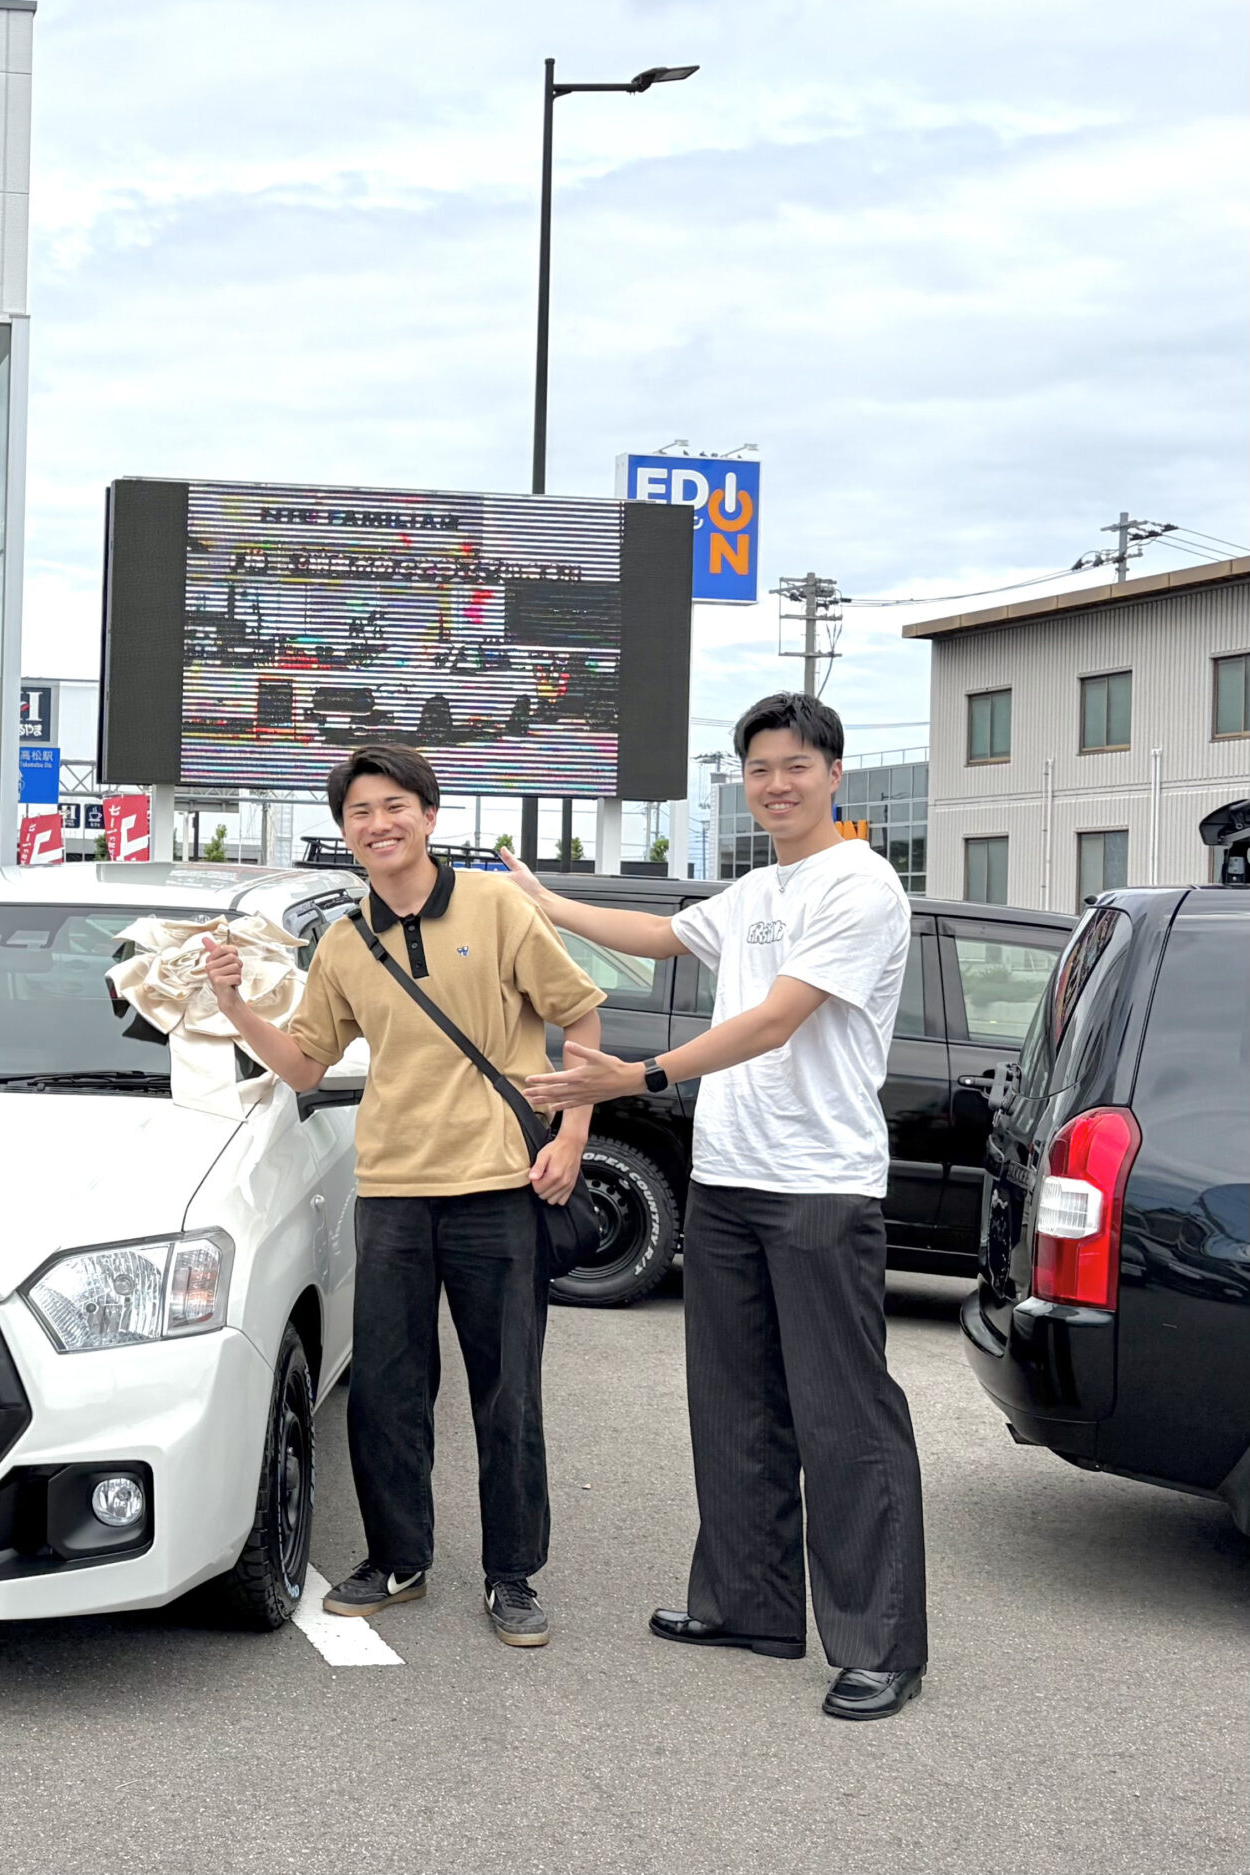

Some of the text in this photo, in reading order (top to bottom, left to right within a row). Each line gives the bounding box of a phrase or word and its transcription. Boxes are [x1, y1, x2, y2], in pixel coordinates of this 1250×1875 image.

[582, 1152, 660, 1276] OPEN COUNTRY R/T
